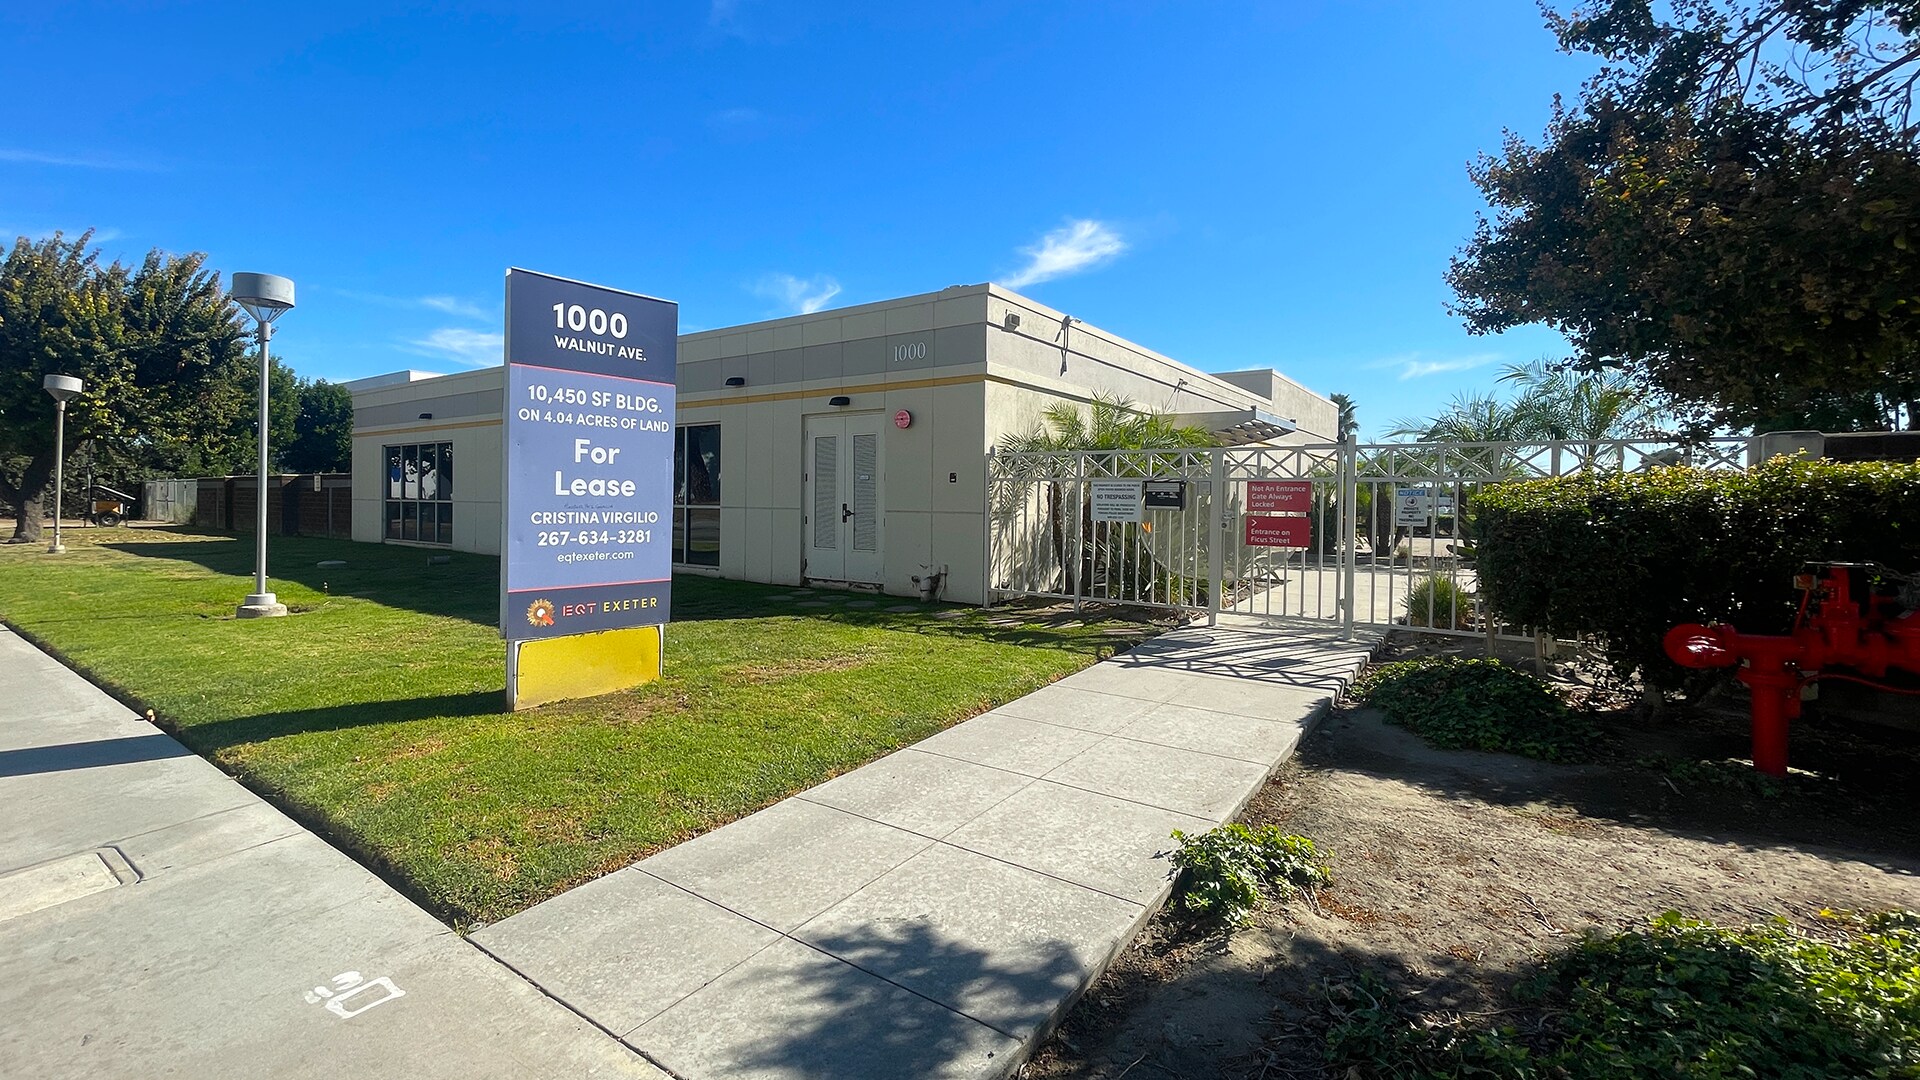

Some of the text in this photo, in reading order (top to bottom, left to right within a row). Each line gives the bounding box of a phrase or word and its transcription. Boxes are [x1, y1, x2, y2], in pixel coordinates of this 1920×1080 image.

[552, 302, 628, 340] 1000
[554, 334, 647, 362] WALNUT AVE.
[894, 342, 926, 362] 1000
[528, 384, 662, 414] 10,450 SF BLDG.
[518, 408, 670, 433] ON 4.04 ACRES OF LAND
[574, 438, 620, 464] For
[555, 470, 636, 498] Lease
[1268, 493, 1292, 501] Always
[530, 511, 659, 525] CRISTINA VIRGILIO
[537, 530, 652, 547] 267-634-3281
[557, 550, 634, 564] eqtexeter.com
[562, 598, 658, 617] EQT EXETER
